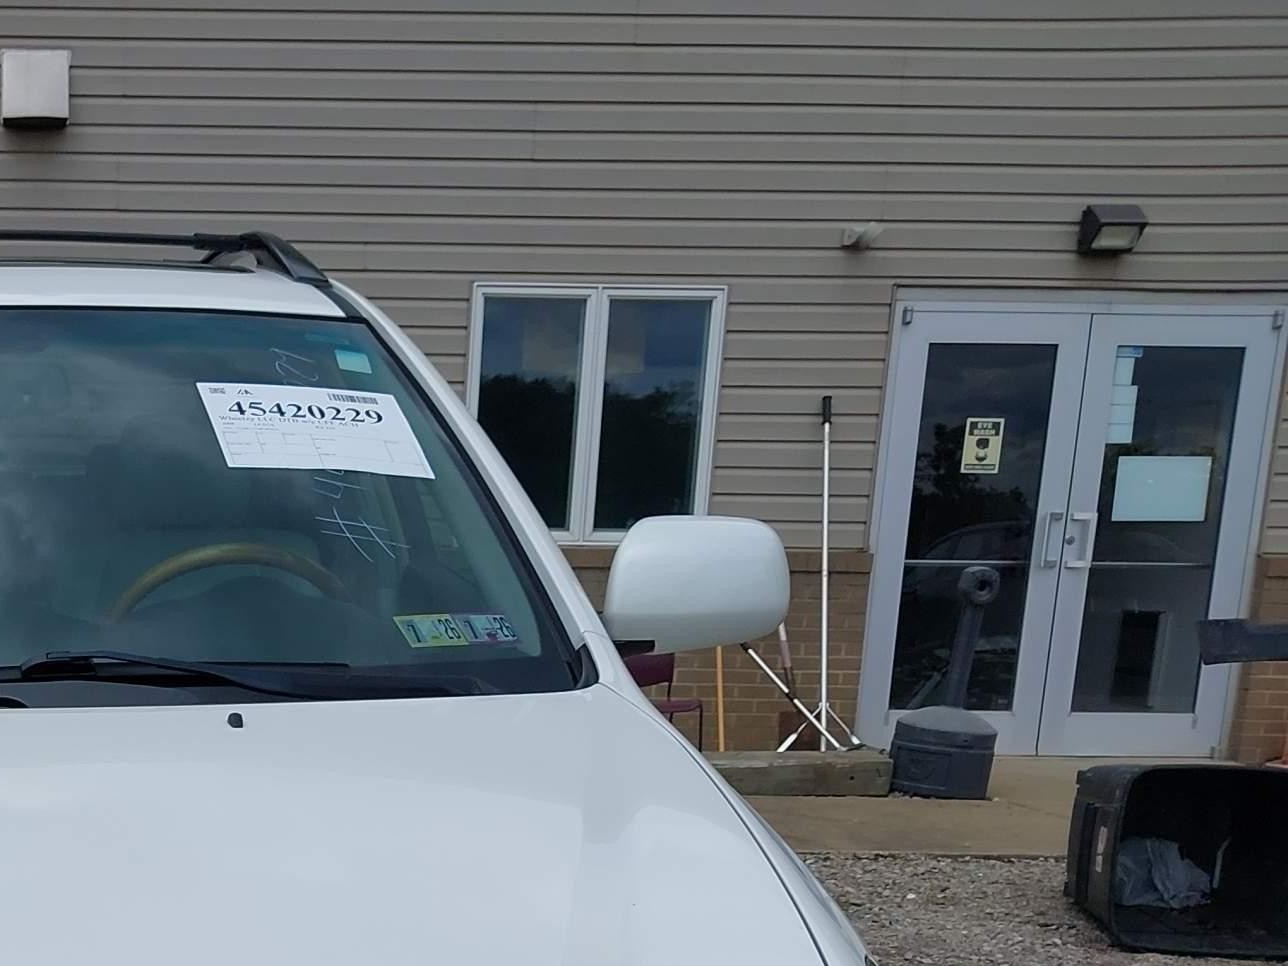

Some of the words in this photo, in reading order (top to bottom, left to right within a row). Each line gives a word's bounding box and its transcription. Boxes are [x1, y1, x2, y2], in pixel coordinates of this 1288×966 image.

[227, 400, 384, 425] 45420229
[437, 618, 461, 640] 26
[492, 616, 517, 638] 26
